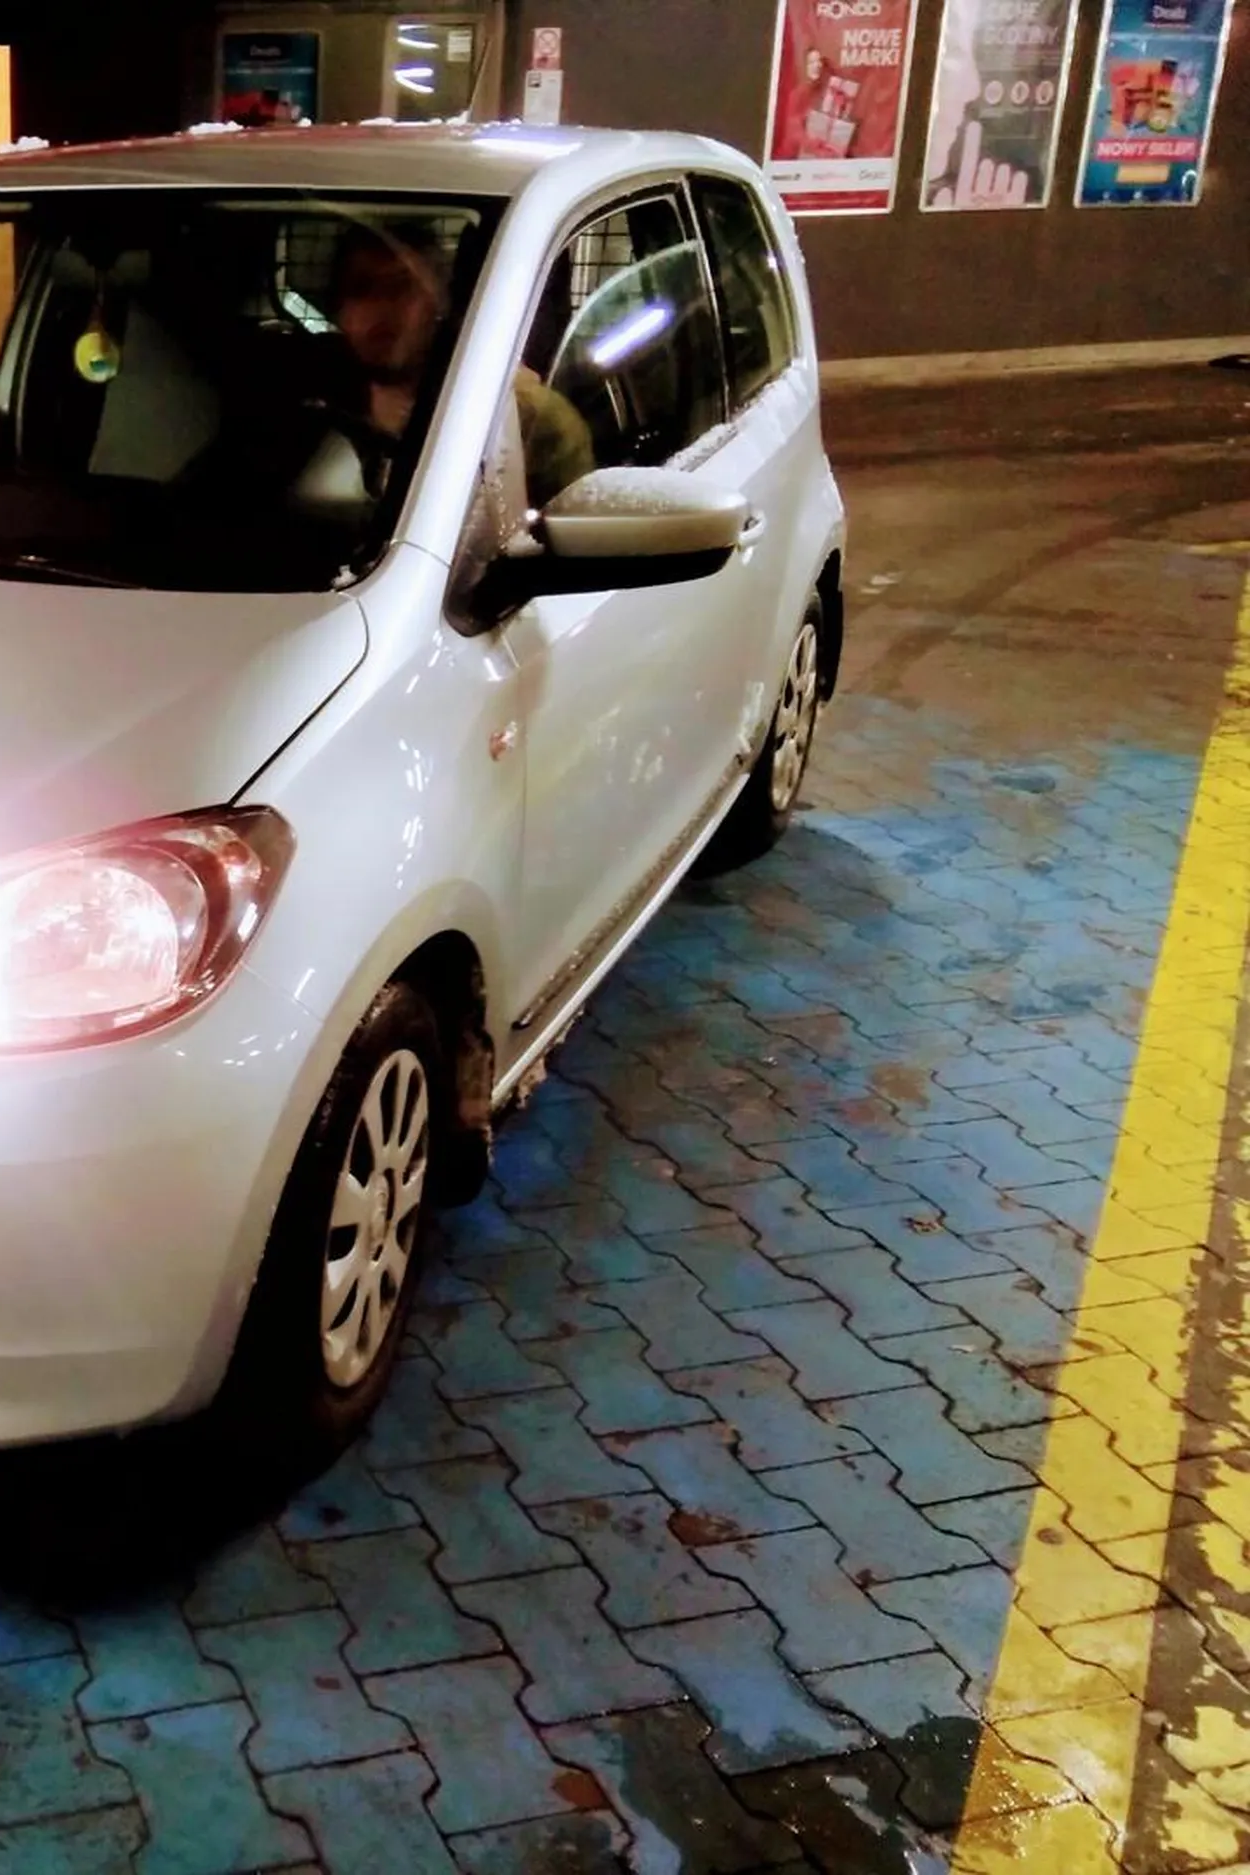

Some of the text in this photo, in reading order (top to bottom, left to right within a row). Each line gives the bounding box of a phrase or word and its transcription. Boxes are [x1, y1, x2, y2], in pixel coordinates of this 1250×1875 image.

[843, 28, 902, 47] NOWE
[840, 48, 900, 68] MARKI
[1097, 141, 1147, 157] NOWY
